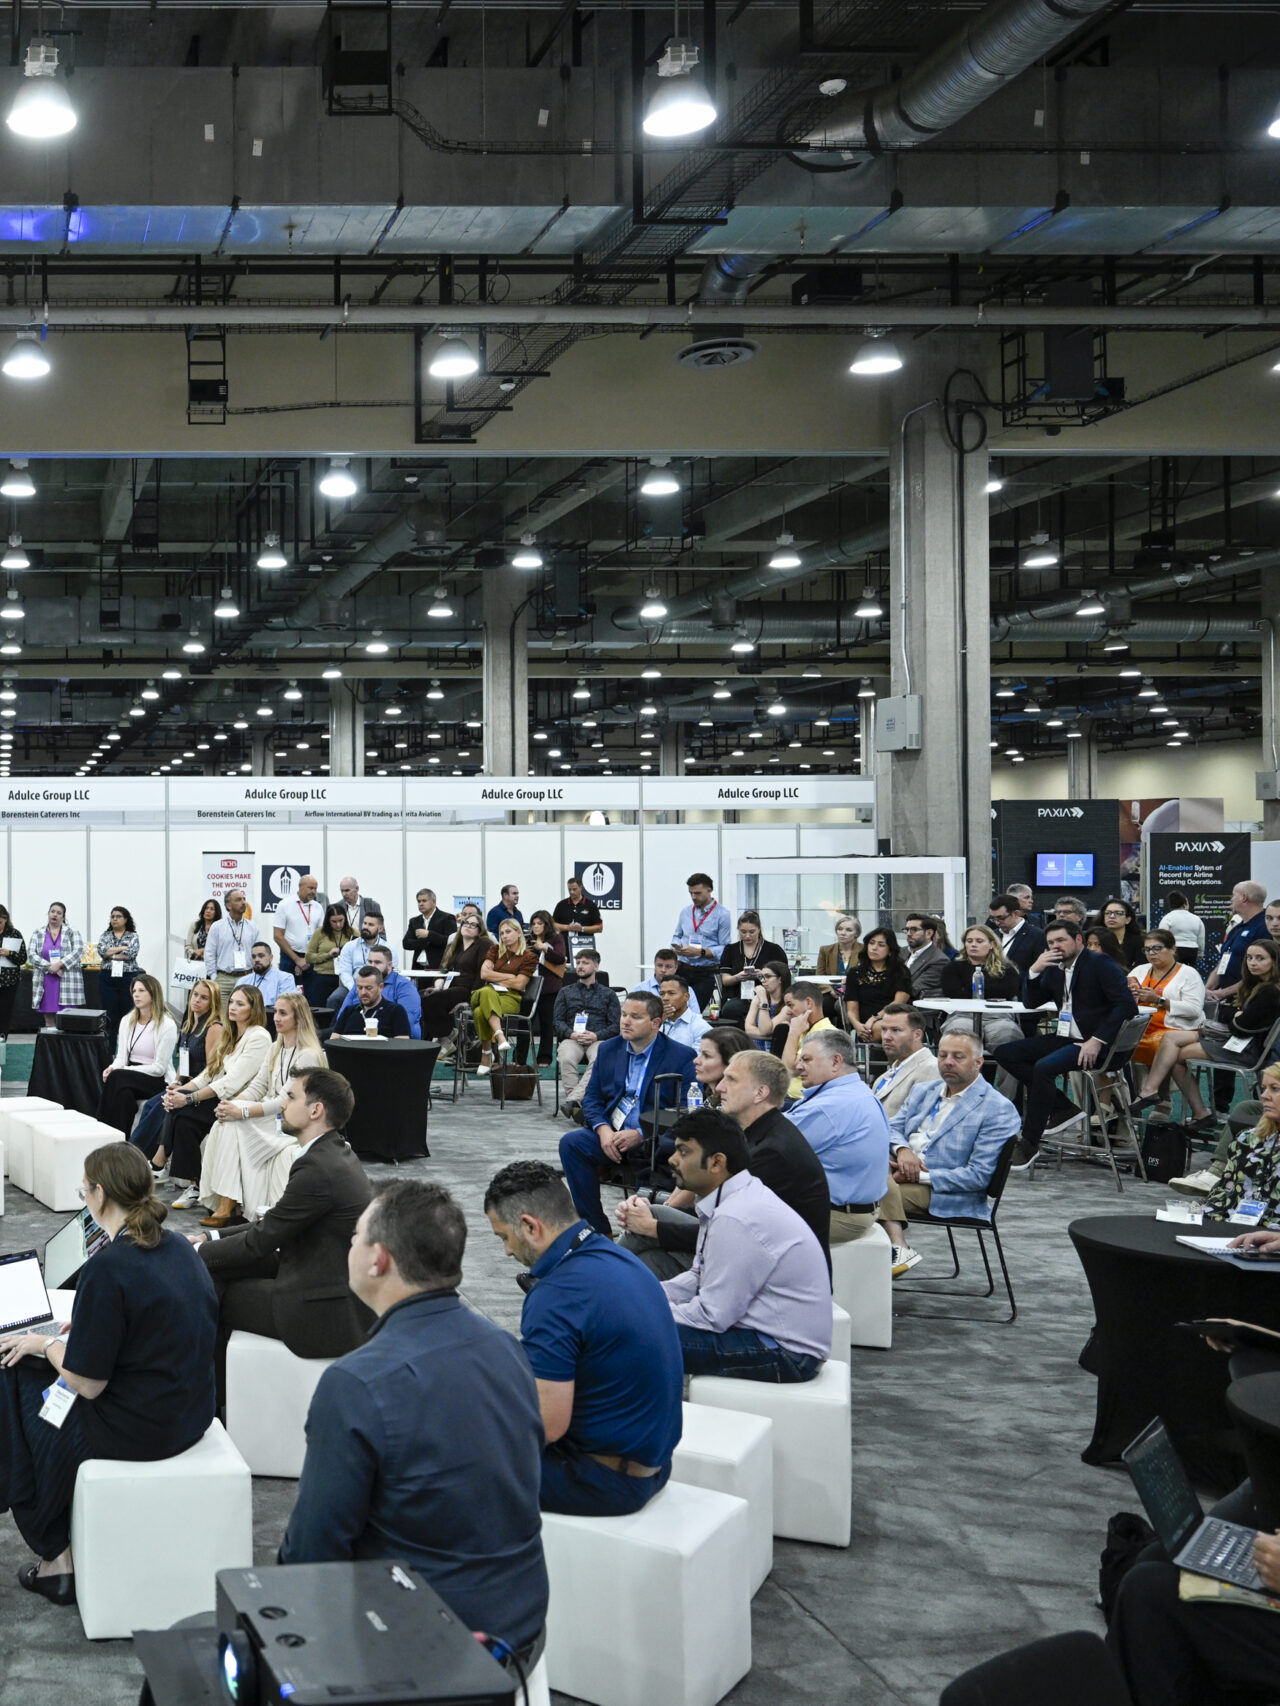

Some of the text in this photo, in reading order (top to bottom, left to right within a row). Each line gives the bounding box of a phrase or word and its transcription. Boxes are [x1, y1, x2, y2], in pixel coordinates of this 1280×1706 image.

[8, 789, 90, 803] Adulce Group LLC
[245, 788, 327, 802] Adulce Group LLC
[482, 788, 564, 801] Adulce Group LLC
[718, 787, 799, 801] Adulce Group LLC
[1, 810, 81, 819] Borenstein Caterers Inc
[197, 810, 276, 818] Borenstein Caterers Inc
[371, 810, 393, 819] trading
[1037, 807, 1071, 818] PAXIA
[1175, 841, 1211, 853] PAXIA
[1194, 864, 1215, 872] Sytem
[1159, 878, 1186, 886] Catering
[593, 899, 620, 909] ULCE
